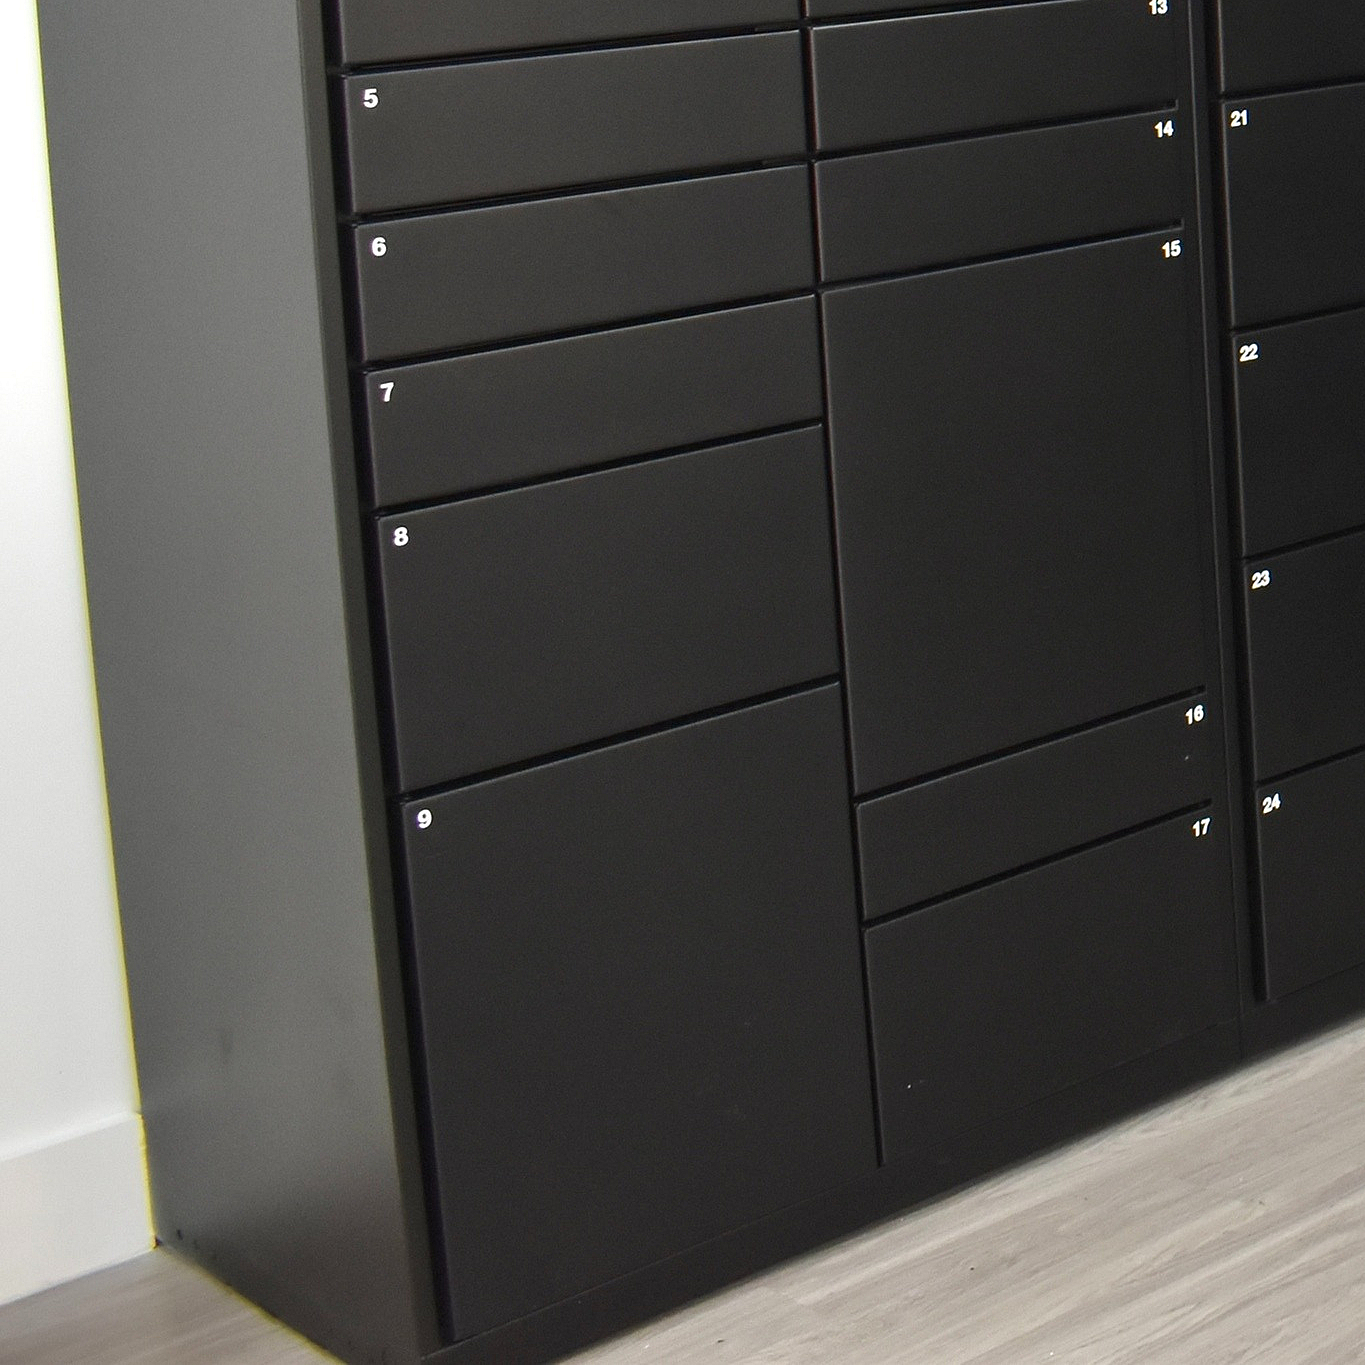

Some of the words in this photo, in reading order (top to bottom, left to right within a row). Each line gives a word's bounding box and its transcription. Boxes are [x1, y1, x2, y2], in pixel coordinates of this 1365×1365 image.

[362, 87, 379, 109] 5
[1154, 119, 1174, 138] 14
[1230, 109, 1248, 128] 21
[370, 236, 387, 257] 6
[1161, 239, 1182, 258] 15
[1239, 343, 1259, 363] 22
[379, 381, 395, 403] 7
[392, 526, 409, 547] 8
[1251, 569, 1271, 590] 23
[1185, 704, 1205, 725] 16
[1262, 793, 1281, 814] 24
[416, 809, 433, 829] 9
[1192, 817, 1211, 837] 17
